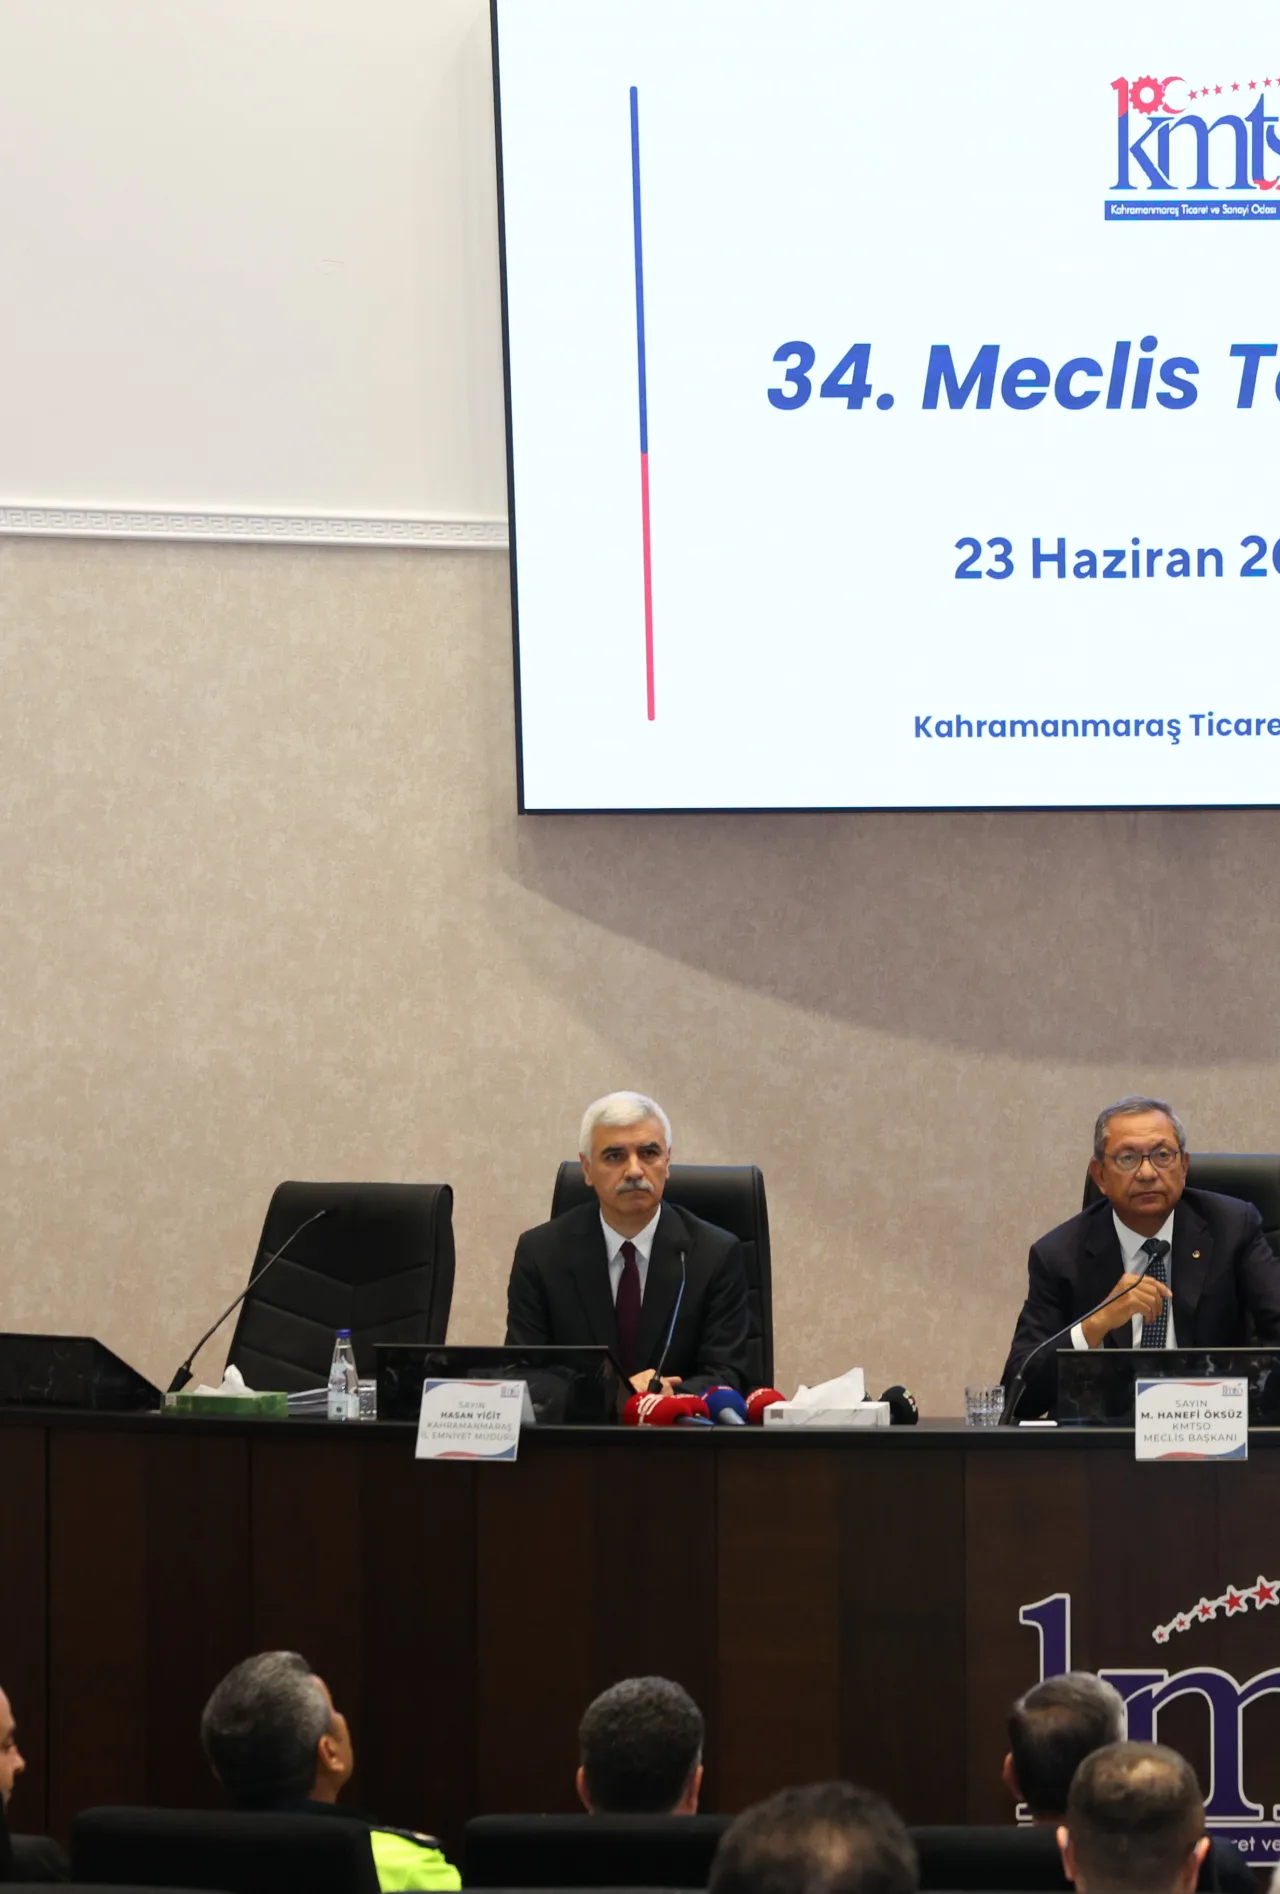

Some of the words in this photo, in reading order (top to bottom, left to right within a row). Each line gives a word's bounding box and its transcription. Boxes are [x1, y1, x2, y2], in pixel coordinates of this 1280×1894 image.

[1110, 204, 1179, 217] Kahramanmaraş
[1181, 204, 1208, 215] Ticaret
[1210, 207, 1220, 215] ve
[1222, 203, 1249, 217] Sanayi
[1251, 203, 1277, 215] Odası
[768, 341, 895, 411] 34.
[922, 336, 1200, 411] Meclis
[955, 537, 1015, 580] 23
[1032, 537, 1224, 579] Haziran
[914, 714, 1182, 746] Kahramanmaraş
[458, 1400, 486, 1409] SAYIN
[1175, 1399, 1208, 1408] SAYIN
[440, 1411, 474, 1420] HASAN
[1141, 1412, 1153, 1420] M.
[1158, 1410, 1200, 1420] HANEFİ
[1204, 1409, 1243, 1419] ÖKSÜZ
[1172, 1422, 1212, 1431] KMTSO
[1143, 1433, 1185, 1443] MECLİS
[1188, 1433, 1238, 1444] BAŞKANI
